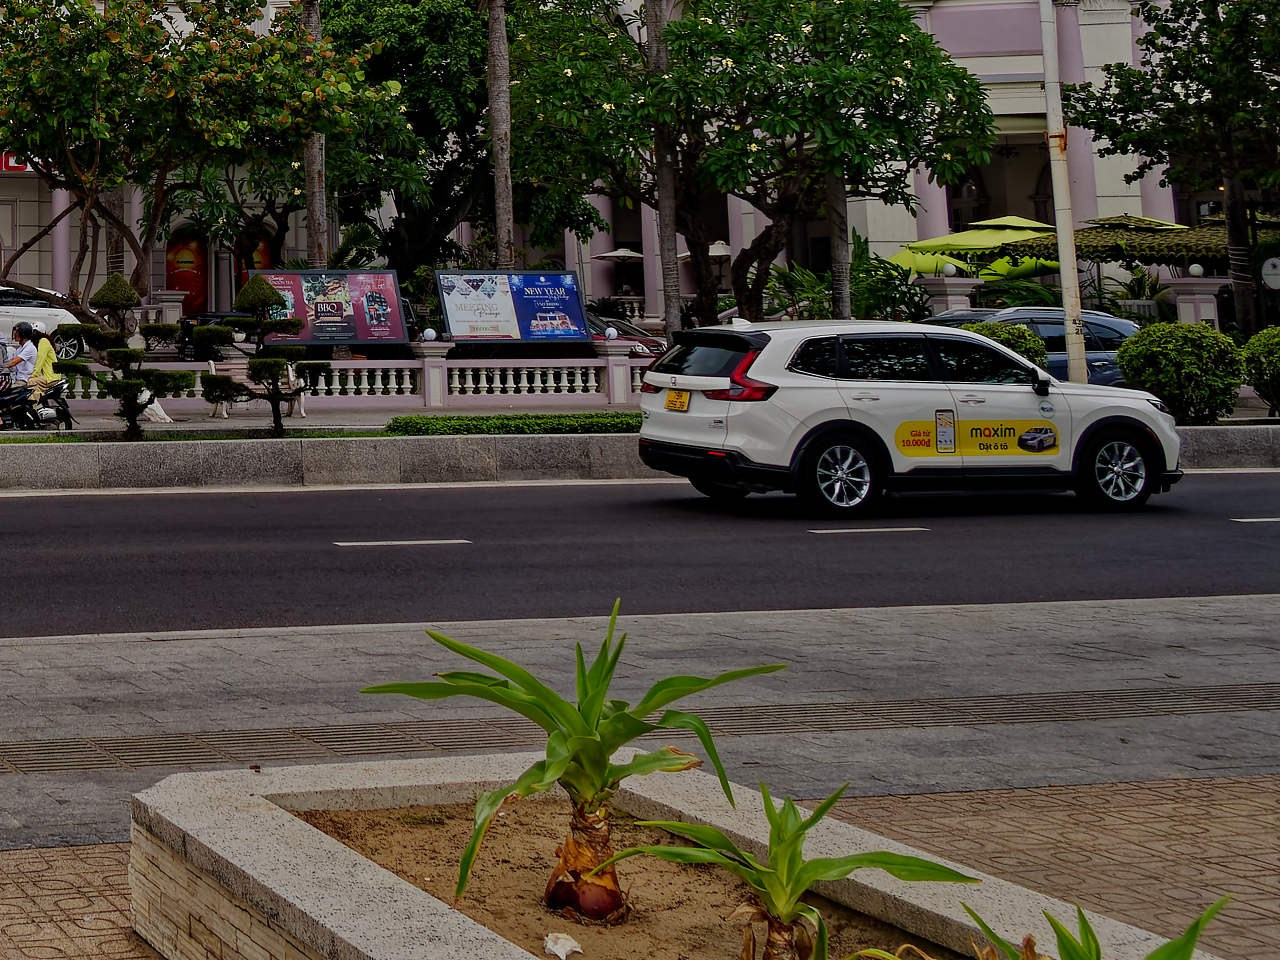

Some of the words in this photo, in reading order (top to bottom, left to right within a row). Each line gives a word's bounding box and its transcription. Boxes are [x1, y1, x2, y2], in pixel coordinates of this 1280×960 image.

[524, 287, 543, 295] NEW
[544, 287, 566, 296] YEAR
[317, 303, 337, 313] BBQ
[970, 423, 1016, 438] maxim
[978, 442, 992, 452] Đặt
